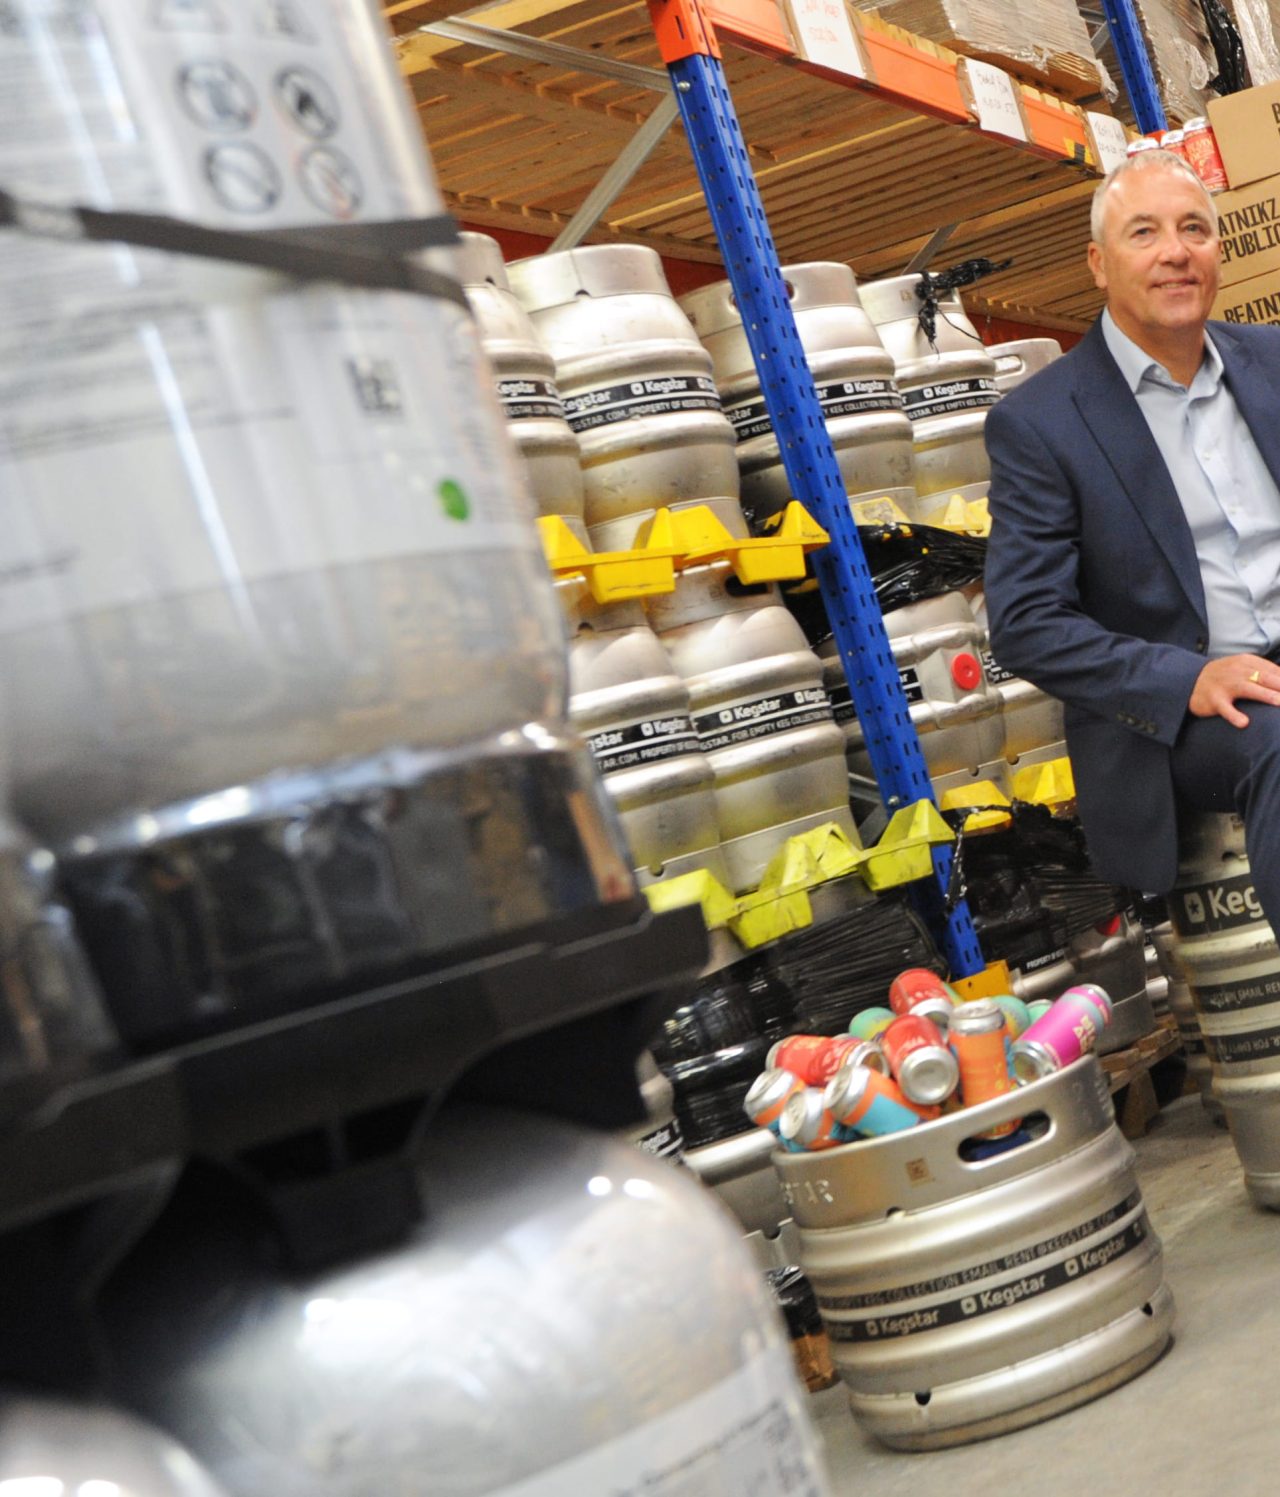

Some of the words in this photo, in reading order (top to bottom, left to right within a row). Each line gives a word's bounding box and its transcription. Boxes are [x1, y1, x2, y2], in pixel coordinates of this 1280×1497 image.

[1217, 198, 1280, 238] ATNIKZ
[644, 378, 687, 393] Kegstar
[934, 382, 969, 396] Kegstar
[733, 698, 781, 720] Kegstar
[732, 727, 749, 743] FOR
[750, 721, 776, 736] EMPTY
[776, 717, 791, 729] KEG
[962, 1261, 1000, 1284] EMAIL
[880, 1309, 940, 1336] Kegstar
[980, 1273, 1047, 1308] Kegstar
[1080, 1235, 1126, 1269] Kegstar
